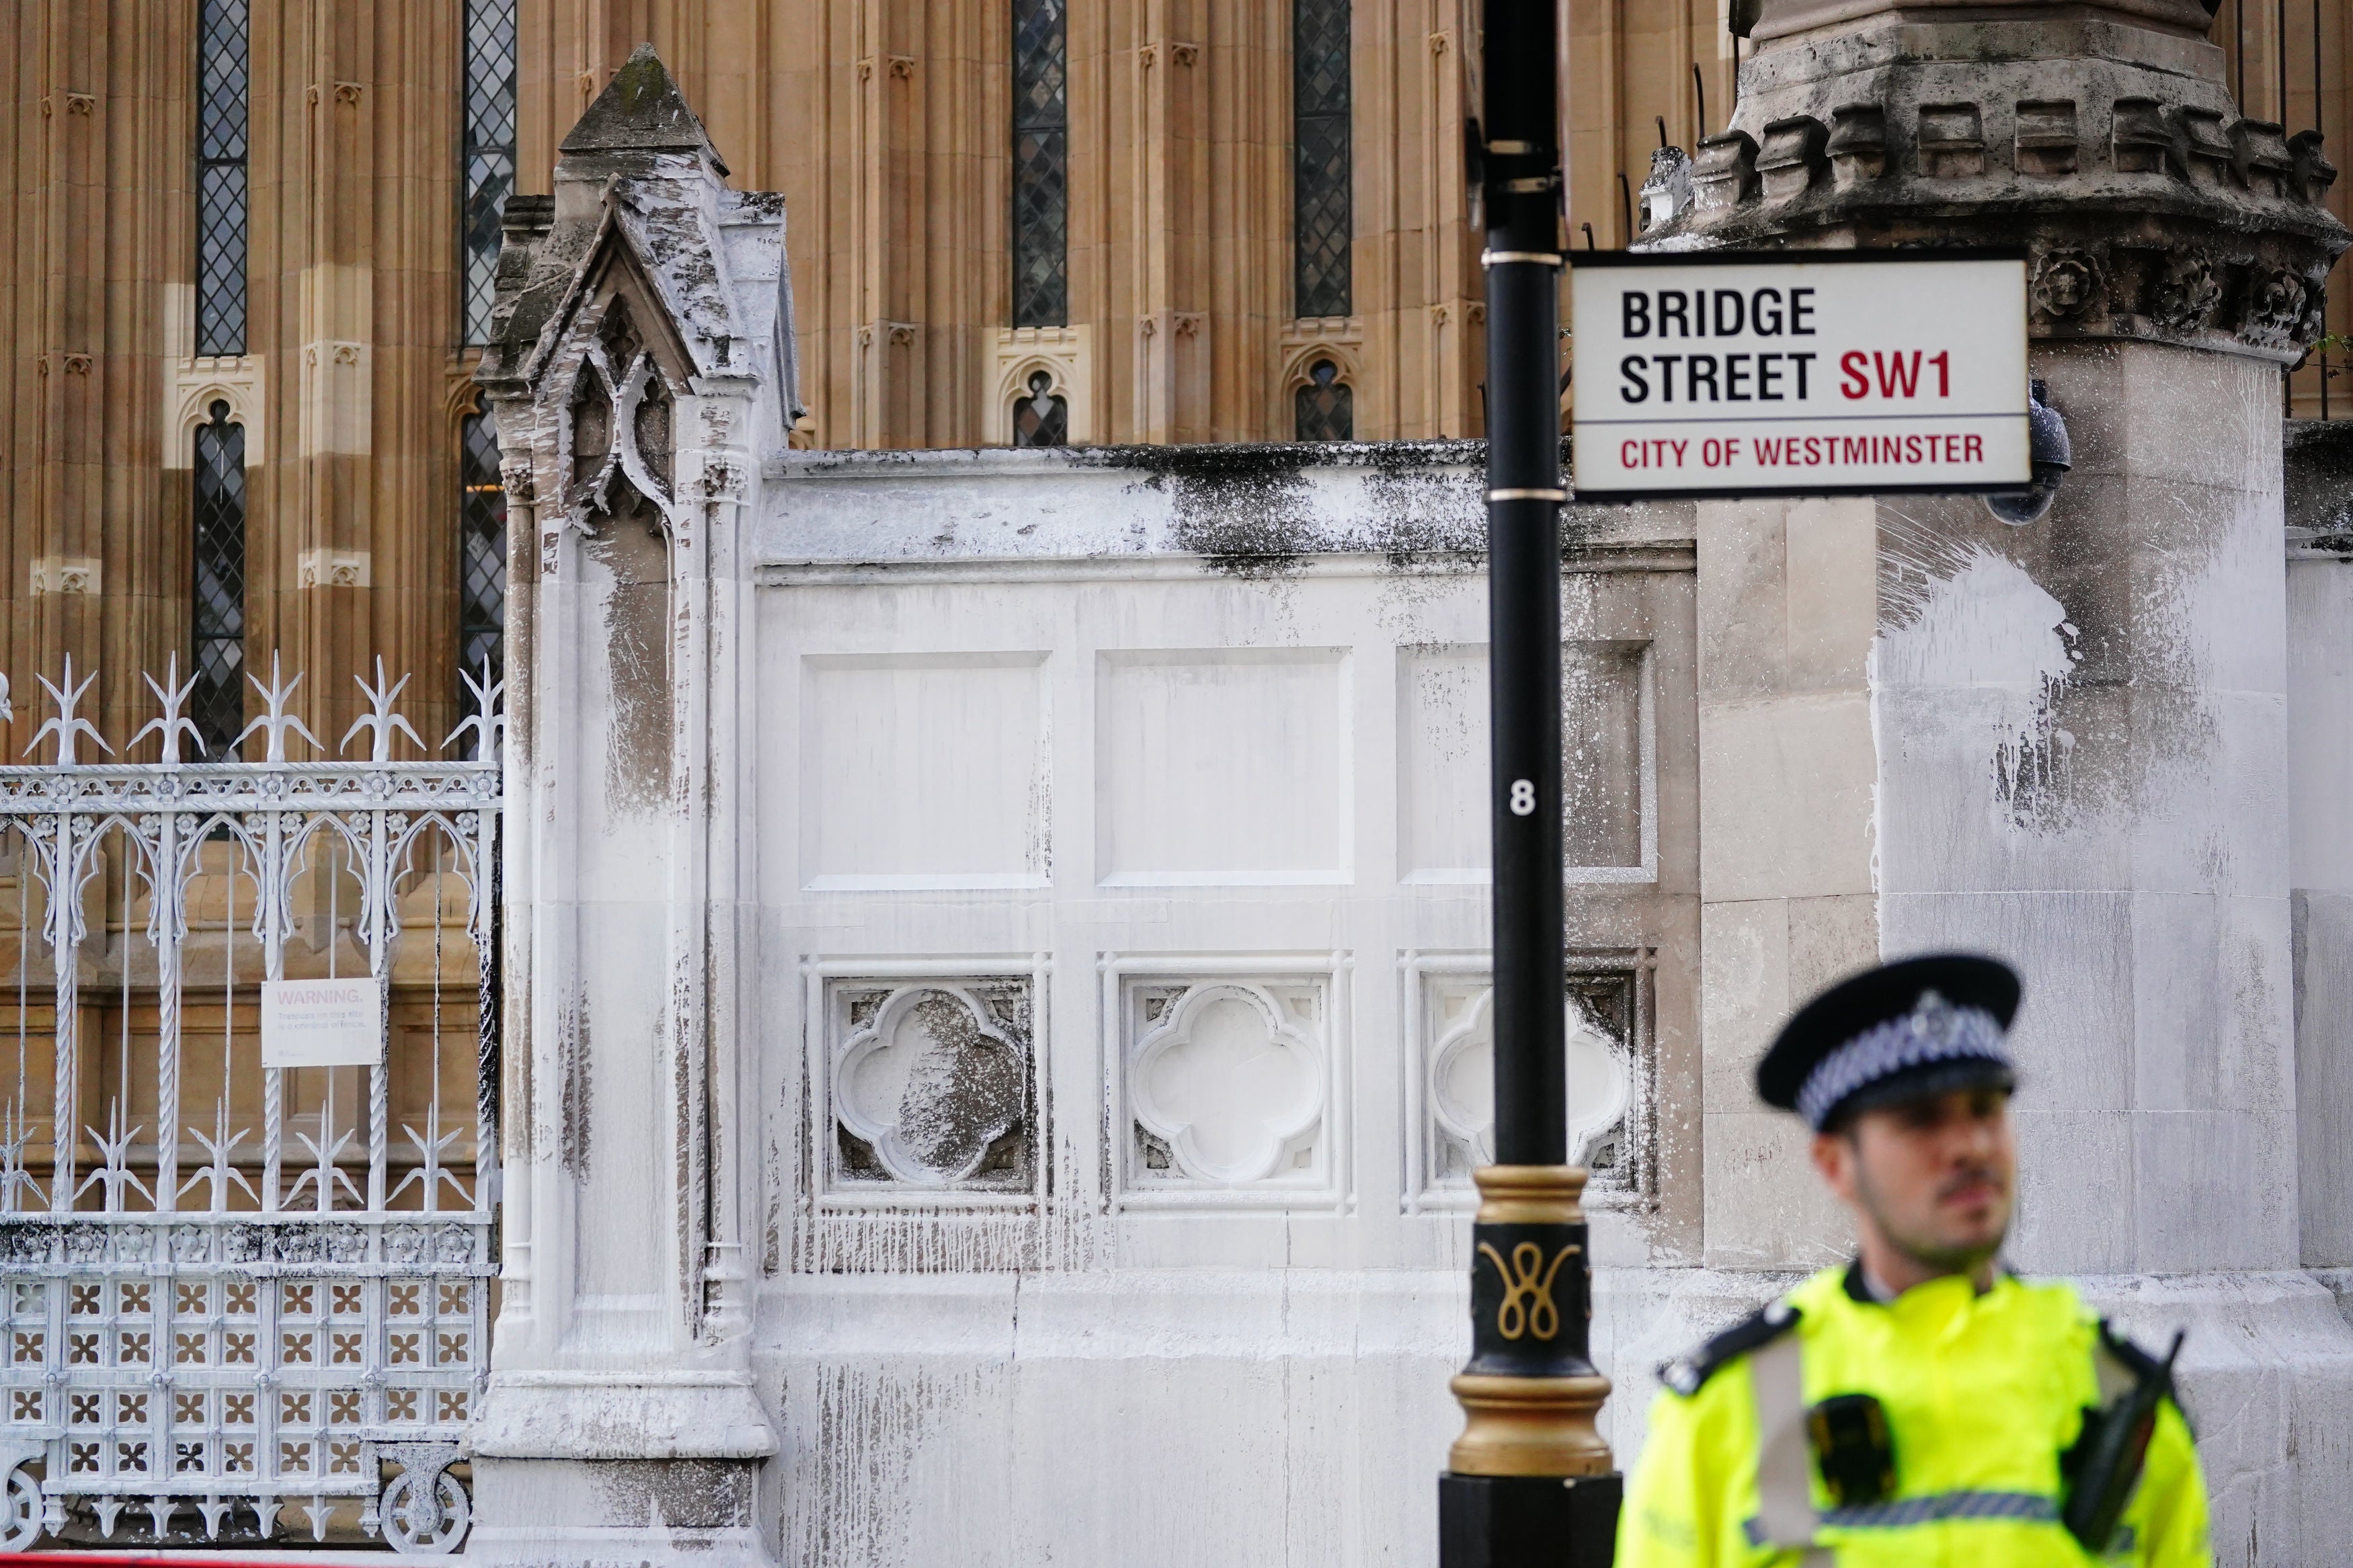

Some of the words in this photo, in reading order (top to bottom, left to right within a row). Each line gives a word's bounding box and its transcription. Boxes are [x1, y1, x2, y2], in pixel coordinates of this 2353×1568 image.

[1621, 286, 1817, 339] BRIDGE
[1620, 351, 1818, 405] STREET
[1839, 349, 1950, 401] SW1
[1620, 439, 1689, 470] CITY
[1702, 438, 1741, 468] OF
[1753, 434, 1984, 467] WESTMINSTER
[1509, 778, 1536, 817] 8
[277, 989, 364, 1005] WARNING.
[278, 1012, 315, 1021] Trespass
[329, 1011, 346, 1019] this
[348, 1010, 364, 1018] site
[294, 1021, 328, 1029] criminal
[331, 1020, 366, 1028] offence.
